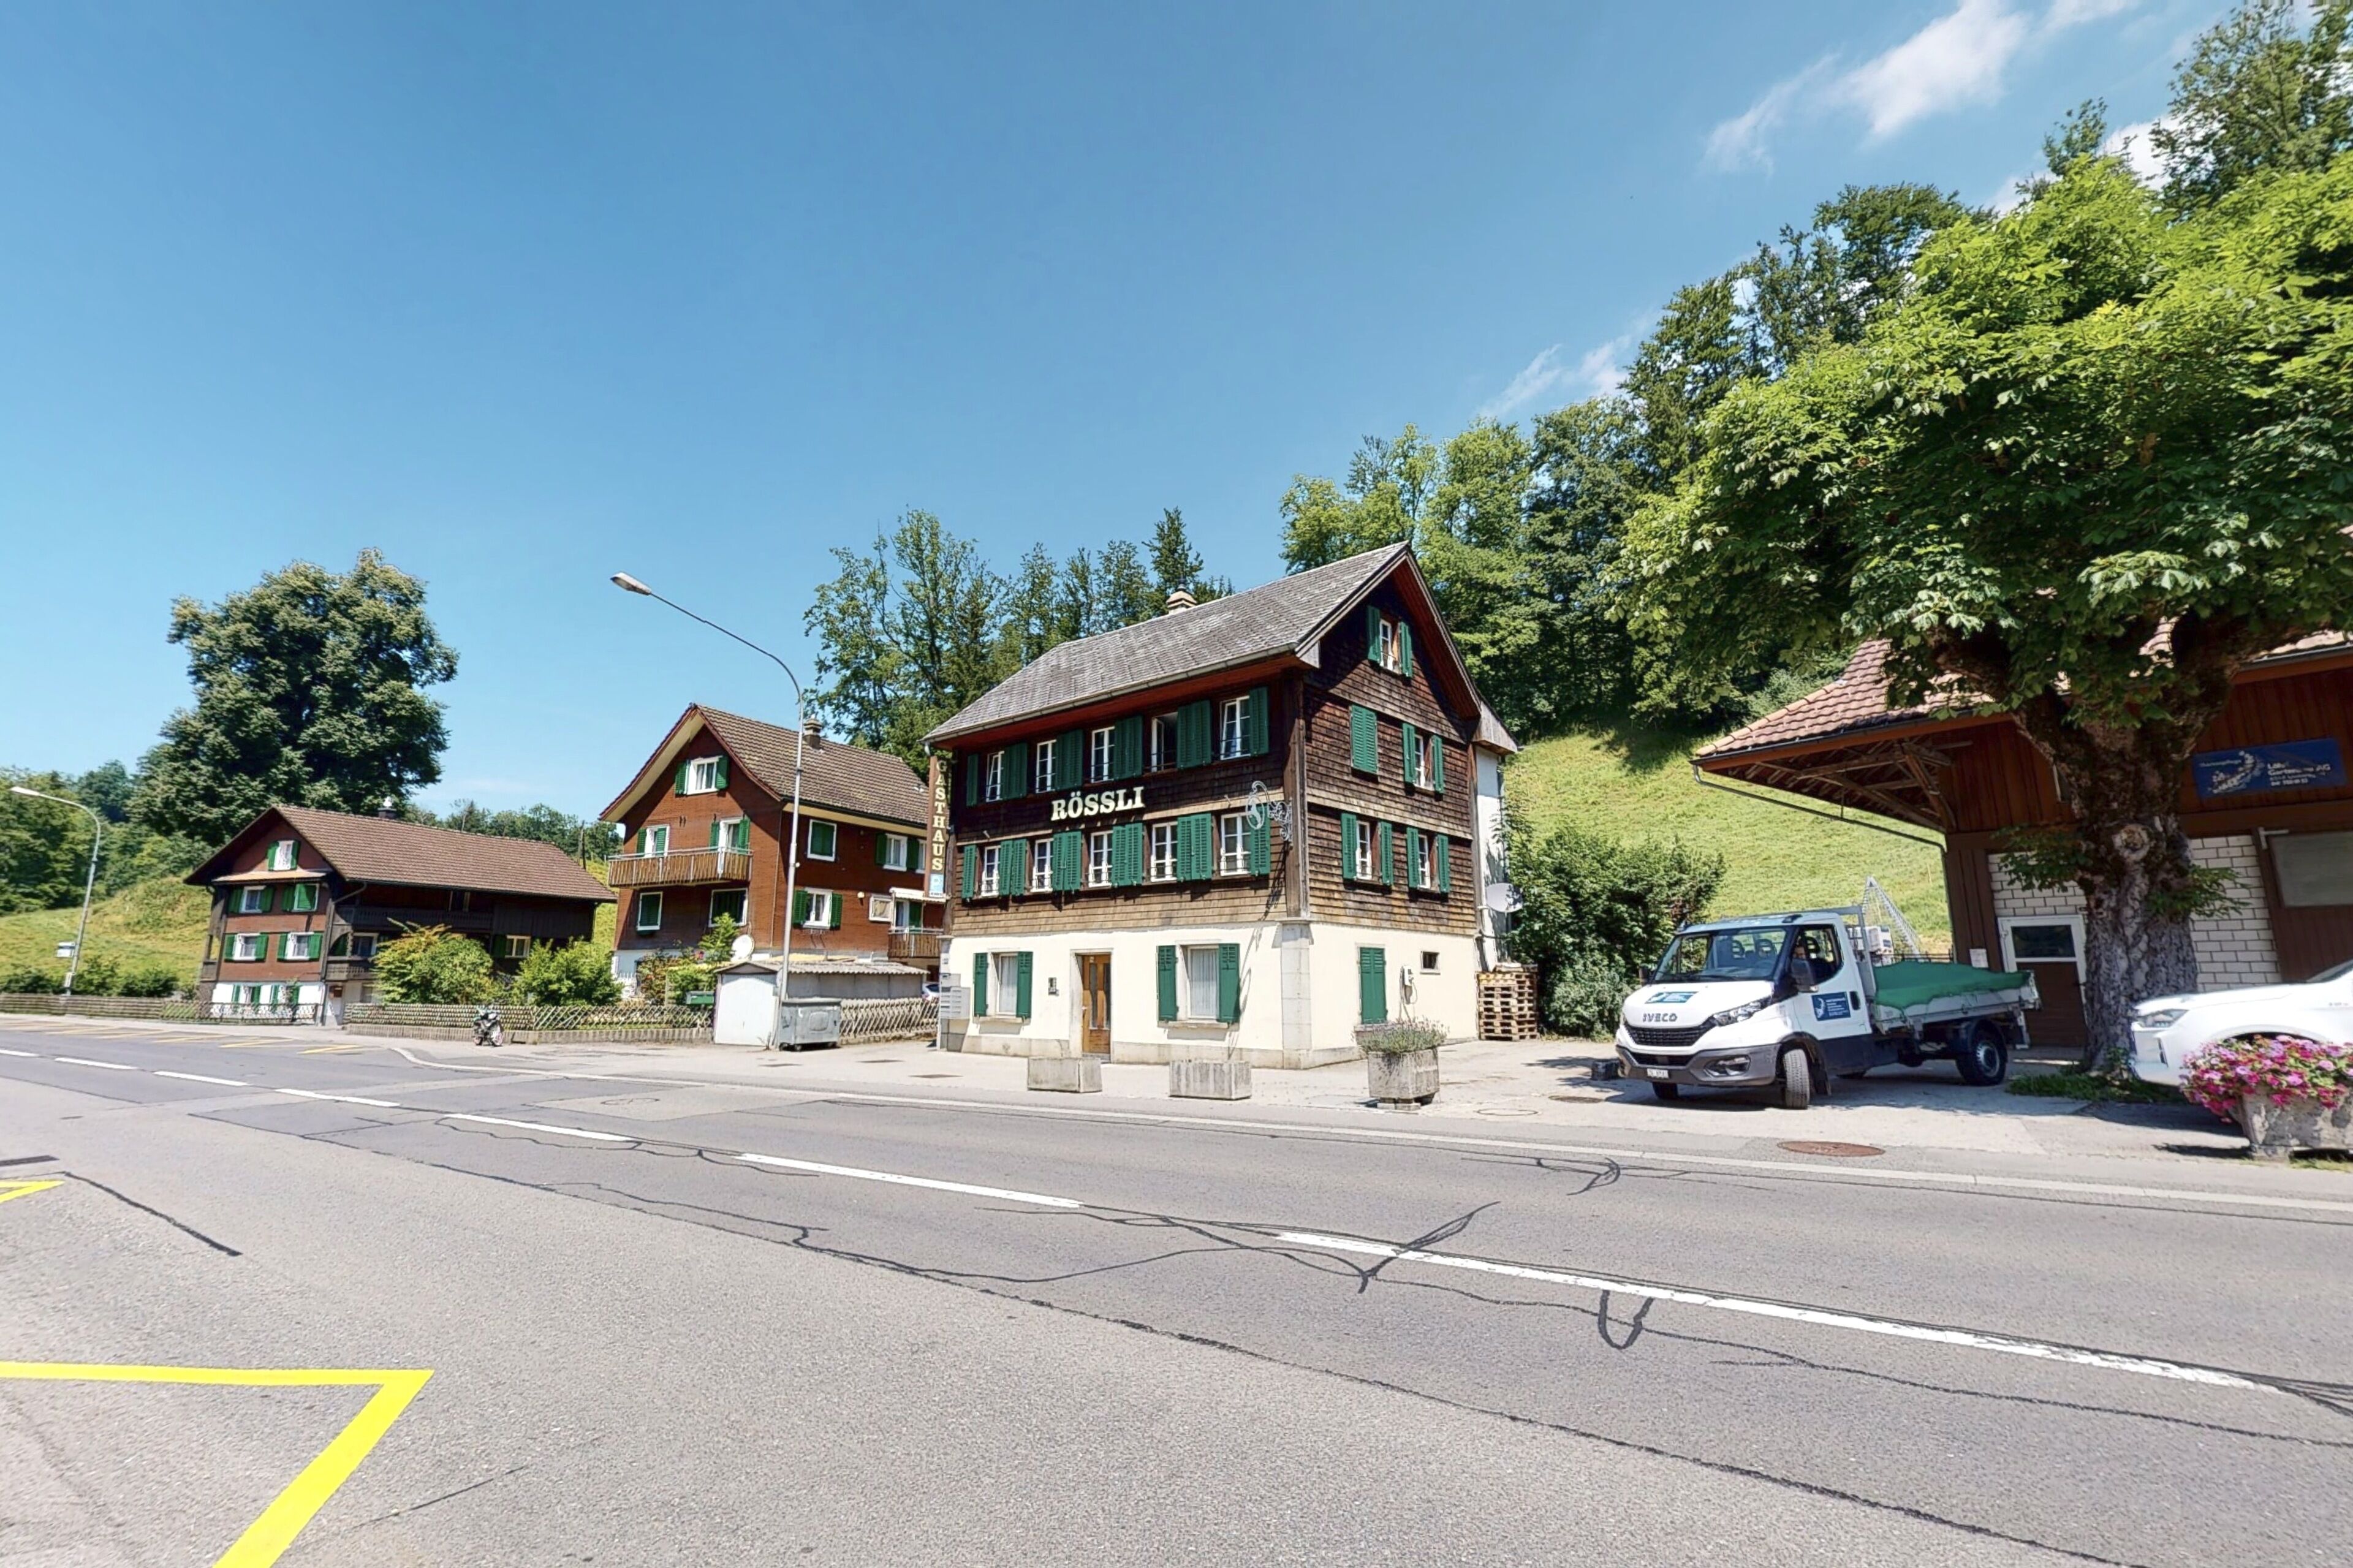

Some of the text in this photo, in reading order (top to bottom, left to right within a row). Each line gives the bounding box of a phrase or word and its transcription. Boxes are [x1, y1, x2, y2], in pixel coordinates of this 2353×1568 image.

[932, 760, 947, 870] GASTHAUS
[1051, 787, 1145, 820] RÖSSLI
[1643, 1013, 1678, 1022] IVECO
